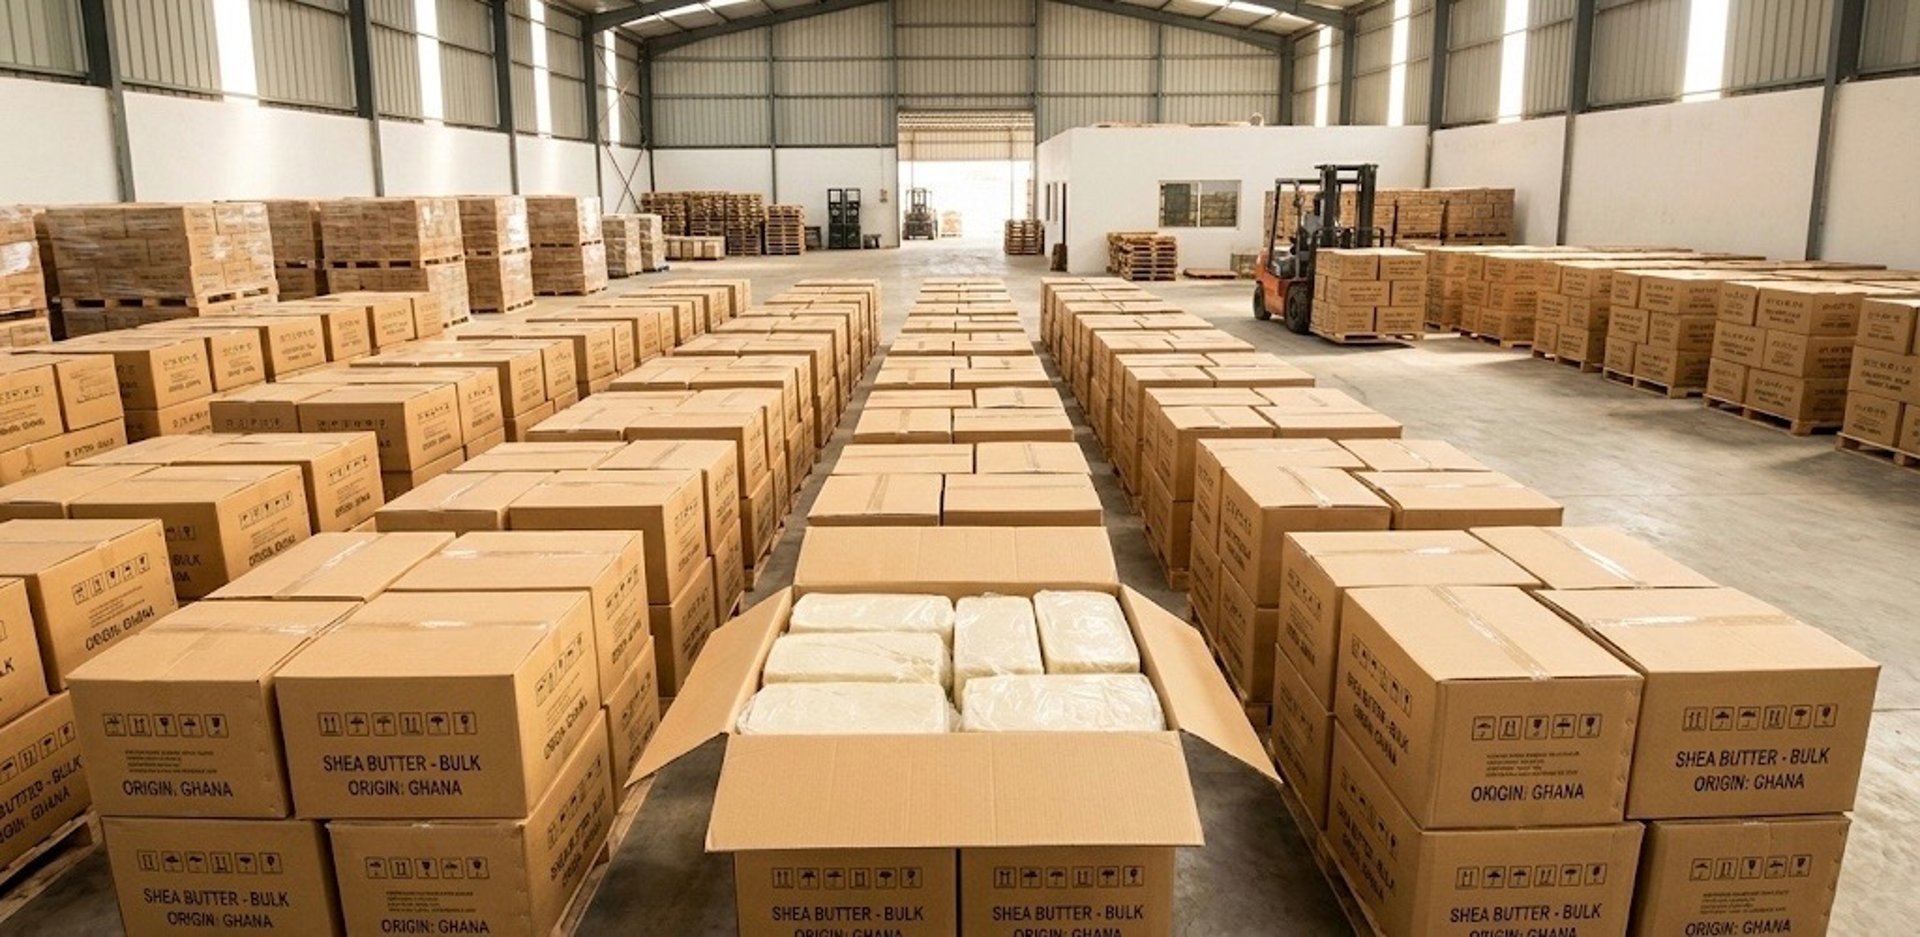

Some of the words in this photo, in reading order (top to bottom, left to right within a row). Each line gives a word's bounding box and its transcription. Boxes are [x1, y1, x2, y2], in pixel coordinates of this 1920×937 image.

[323, 754, 364, 772] SHEA
[367, 755, 427, 772] BUTTER
[439, 755, 481, 772] BULK
[1675, 751, 1716, 768] SHEA
[1719, 749, 1778, 767] BUTTER
[1789, 748, 1830, 765] BULK
[180, 781, 233, 797] GHANA
[348, 780, 404, 796] ORIGIN:
[408, 780, 463, 796] GHANA
[1694, 775, 1750, 792] ORIGIN:
[1753, 773, 1805, 790] GHANA
[1532, 783, 1585, 800] GHANA
[144, 888, 181, 905] SHEA
[183, 890, 239, 906] BUTTER
[250, 891, 290, 907] BULK
[223, 913, 273, 928] GHANA
[772, 905, 811, 921] SHEA
[815, 906, 871, 921] BUTTER
[884, 906, 924, 921] BULK
[992, 905, 1031, 921] SHEA
[1035, 905, 1092, 921] BUTTER
[1105, 904, 1145, 920] BULK
[1450, 906, 1489, 923] SHEA
[1493, 905, 1550, 922] BUTTER
[1562, 903, 1602, 919] BULK
[381, 919, 435, 934] ORIGIN:
[438, 919, 490, 934] GHANA
[1685, 921, 1738, 936] ORIGIN:
[1742, 919, 1791, 935] GHANA
